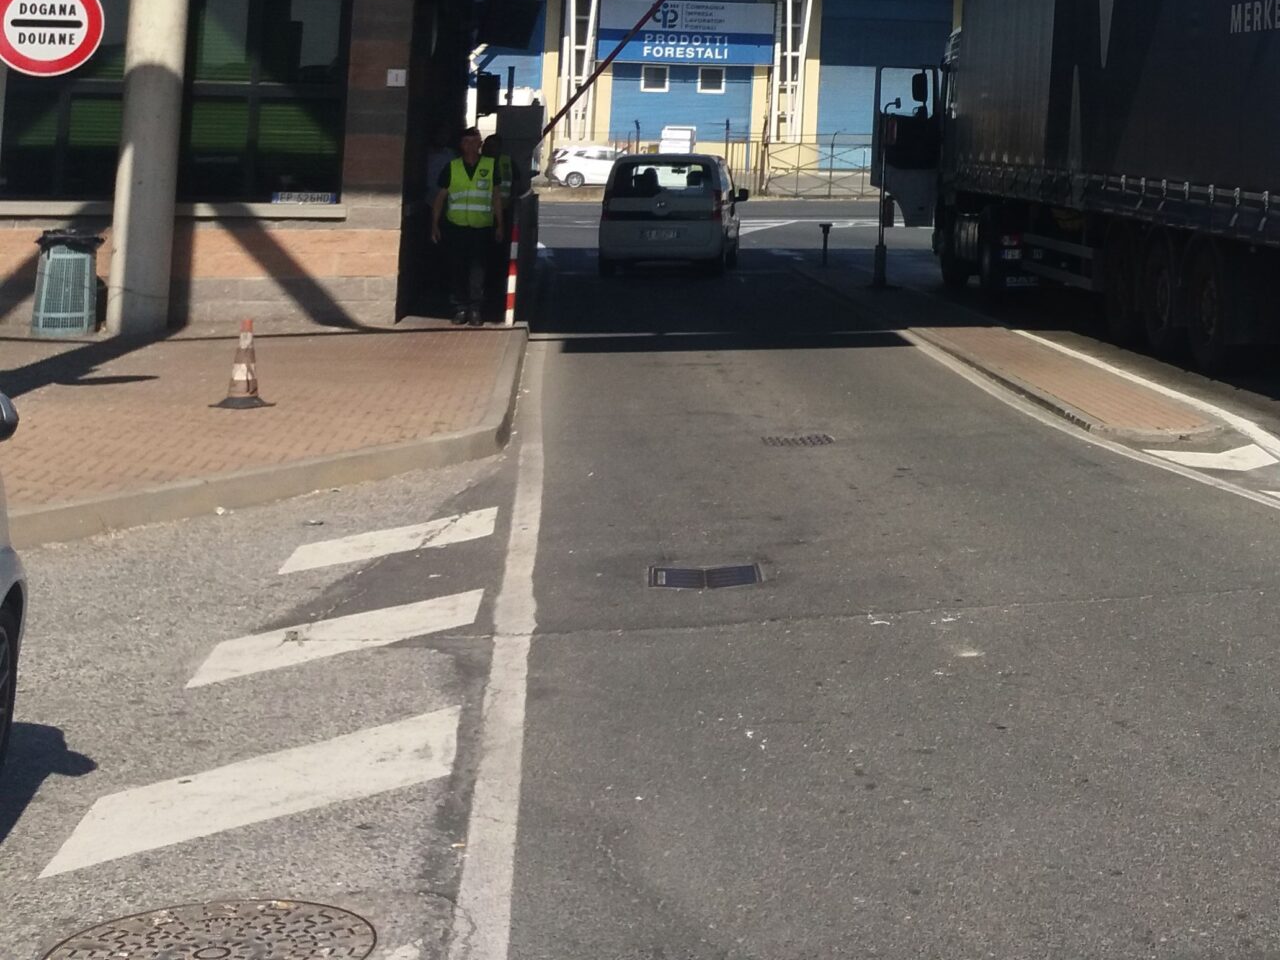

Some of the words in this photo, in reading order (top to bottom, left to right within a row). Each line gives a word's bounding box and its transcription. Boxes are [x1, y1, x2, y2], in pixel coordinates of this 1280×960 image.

[19, 2, 77, 16] DOGANA
[17, 32, 76, 46] DOUANE
[643, 33, 728, 46] PRODOTTI
[643, 45, 728, 59] FORESTALI
